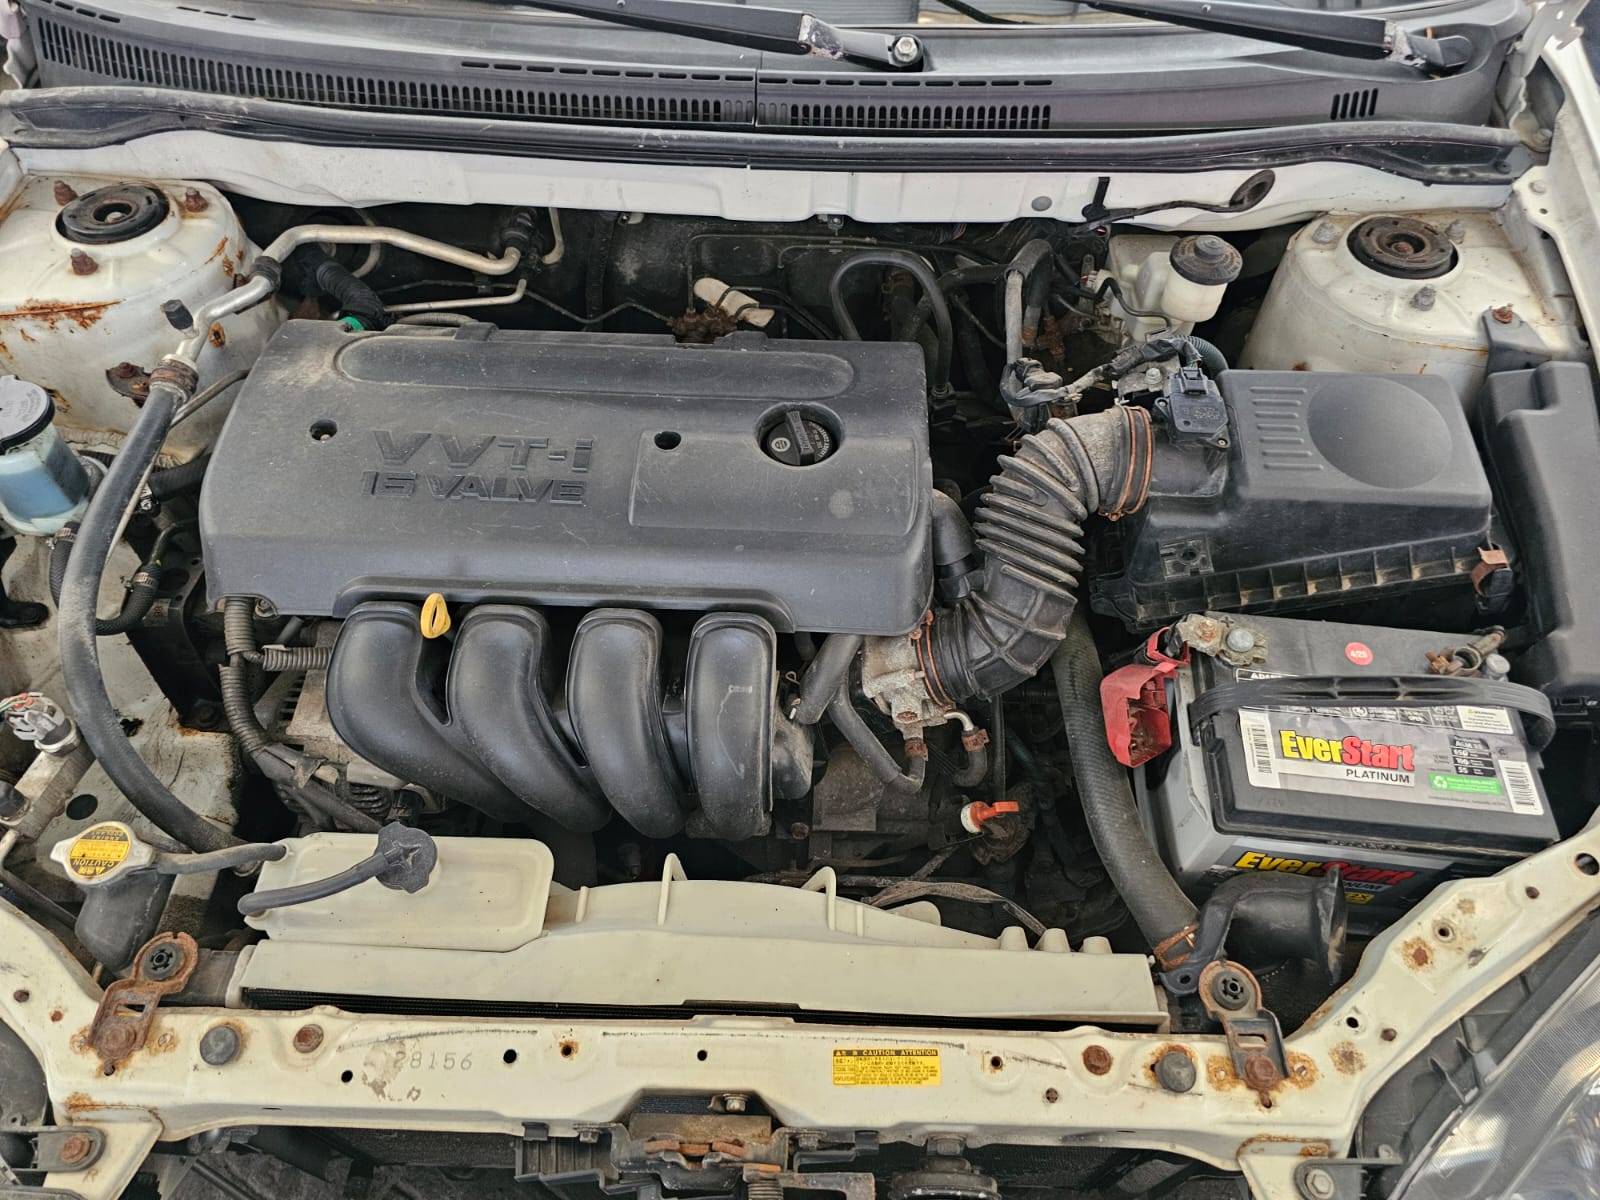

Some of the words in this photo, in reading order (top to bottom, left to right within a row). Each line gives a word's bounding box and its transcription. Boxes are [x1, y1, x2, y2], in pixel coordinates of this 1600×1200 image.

[362, 470, 419, 496] 16
[423, 475, 588, 504] VALVE
[1279, 730, 1415, 771] EverStart
[1346, 768, 1410, 784] PLATINUM
[72, 859, 115, 868] CAUTION
